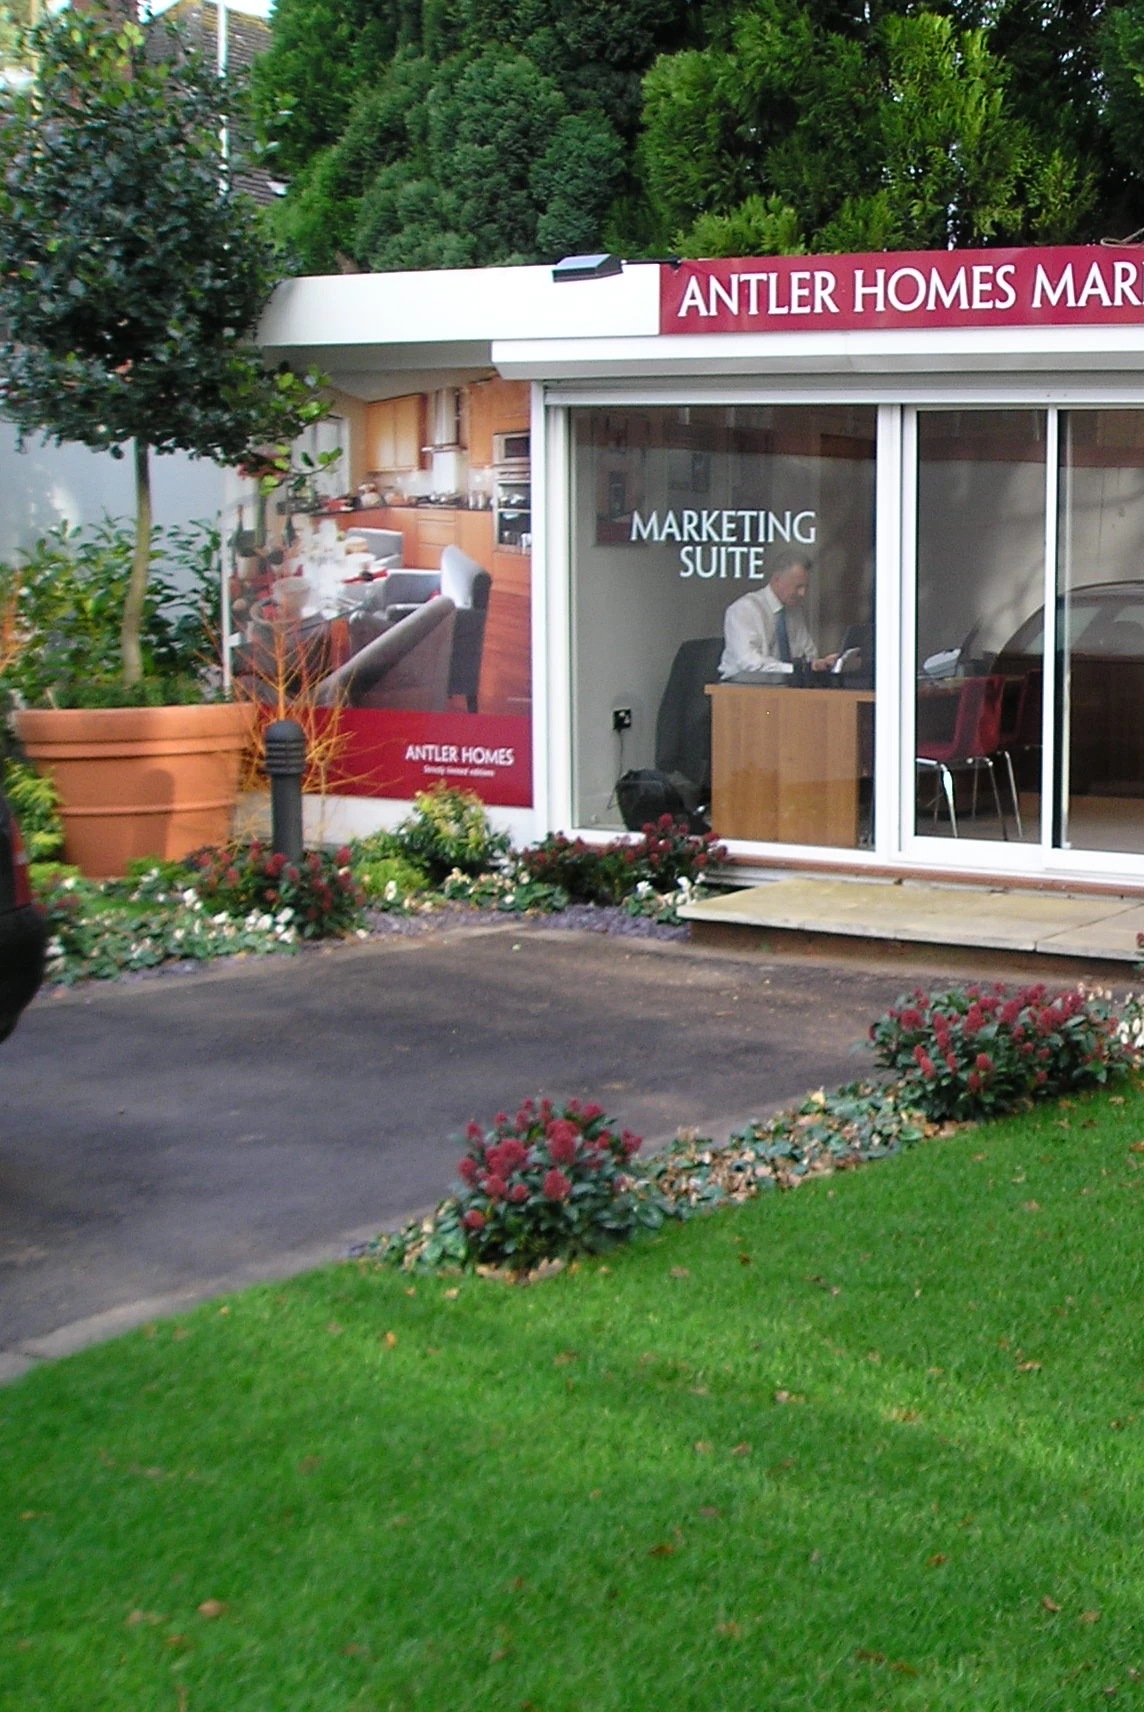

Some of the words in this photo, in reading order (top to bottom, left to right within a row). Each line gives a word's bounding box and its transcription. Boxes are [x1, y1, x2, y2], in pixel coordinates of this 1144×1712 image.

[677, 271, 841, 317] ANTLER
[853, 264, 1017, 313] HOMES
[630, 510, 817, 544] MARKETING
[679, 546, 765, 579] SUITE
[405, 744, 458, 763] ANTLER
[461, 746, 515, 766] HOMES
